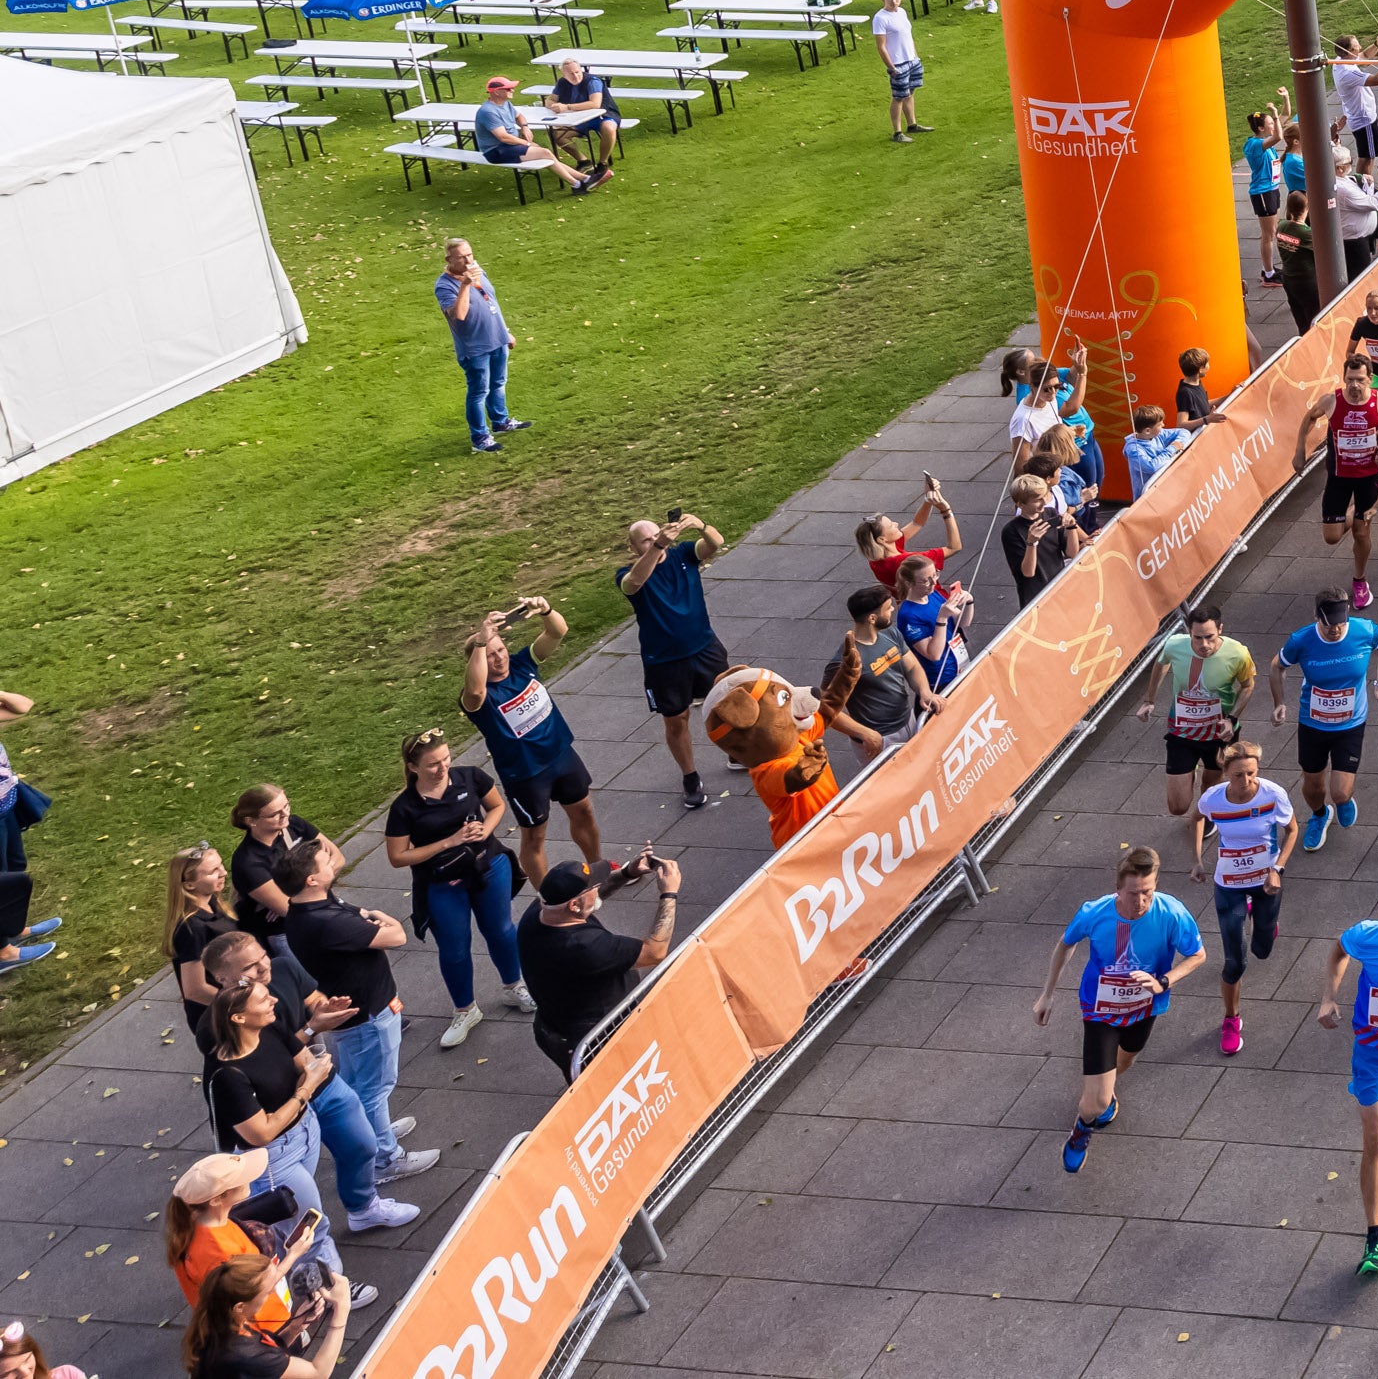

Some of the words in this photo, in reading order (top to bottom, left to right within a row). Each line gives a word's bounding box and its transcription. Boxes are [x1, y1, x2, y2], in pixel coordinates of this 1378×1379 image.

[371, 0, 423, 15] ERDINGER
[1028, 97, 1135, 137] DAK
[1033, 132, 1139, 158] Gesundheit
[1054, 306, 1107, 320] GEMEINSAM.
[1106, 309, 1139, 320] AKTIV
[1345, 437, 1369, 447] 2574
[1135, 477, 1237, 581] GEMEINSAM.
[1231, 418, 1276, 480] AKTIV
[517, 695, 542, 716] 3560
[1184, 705, 1212, 715] 2079
[1317, 697, 1349, 708] 18398
[941, 693, 1009, 786] DAK
[949, 724, 1019, 805] Gesundheit
[1232, 857, 1255, 868] 346
[783, 789, 940, 966] B2Run
[1110, 987, 1143, 998] 1982
[573, 1039, 670, 1175] DAK
[590, 1077, 679, 1196] Gesundheit
[569, 1163, 600, 1208] powered
